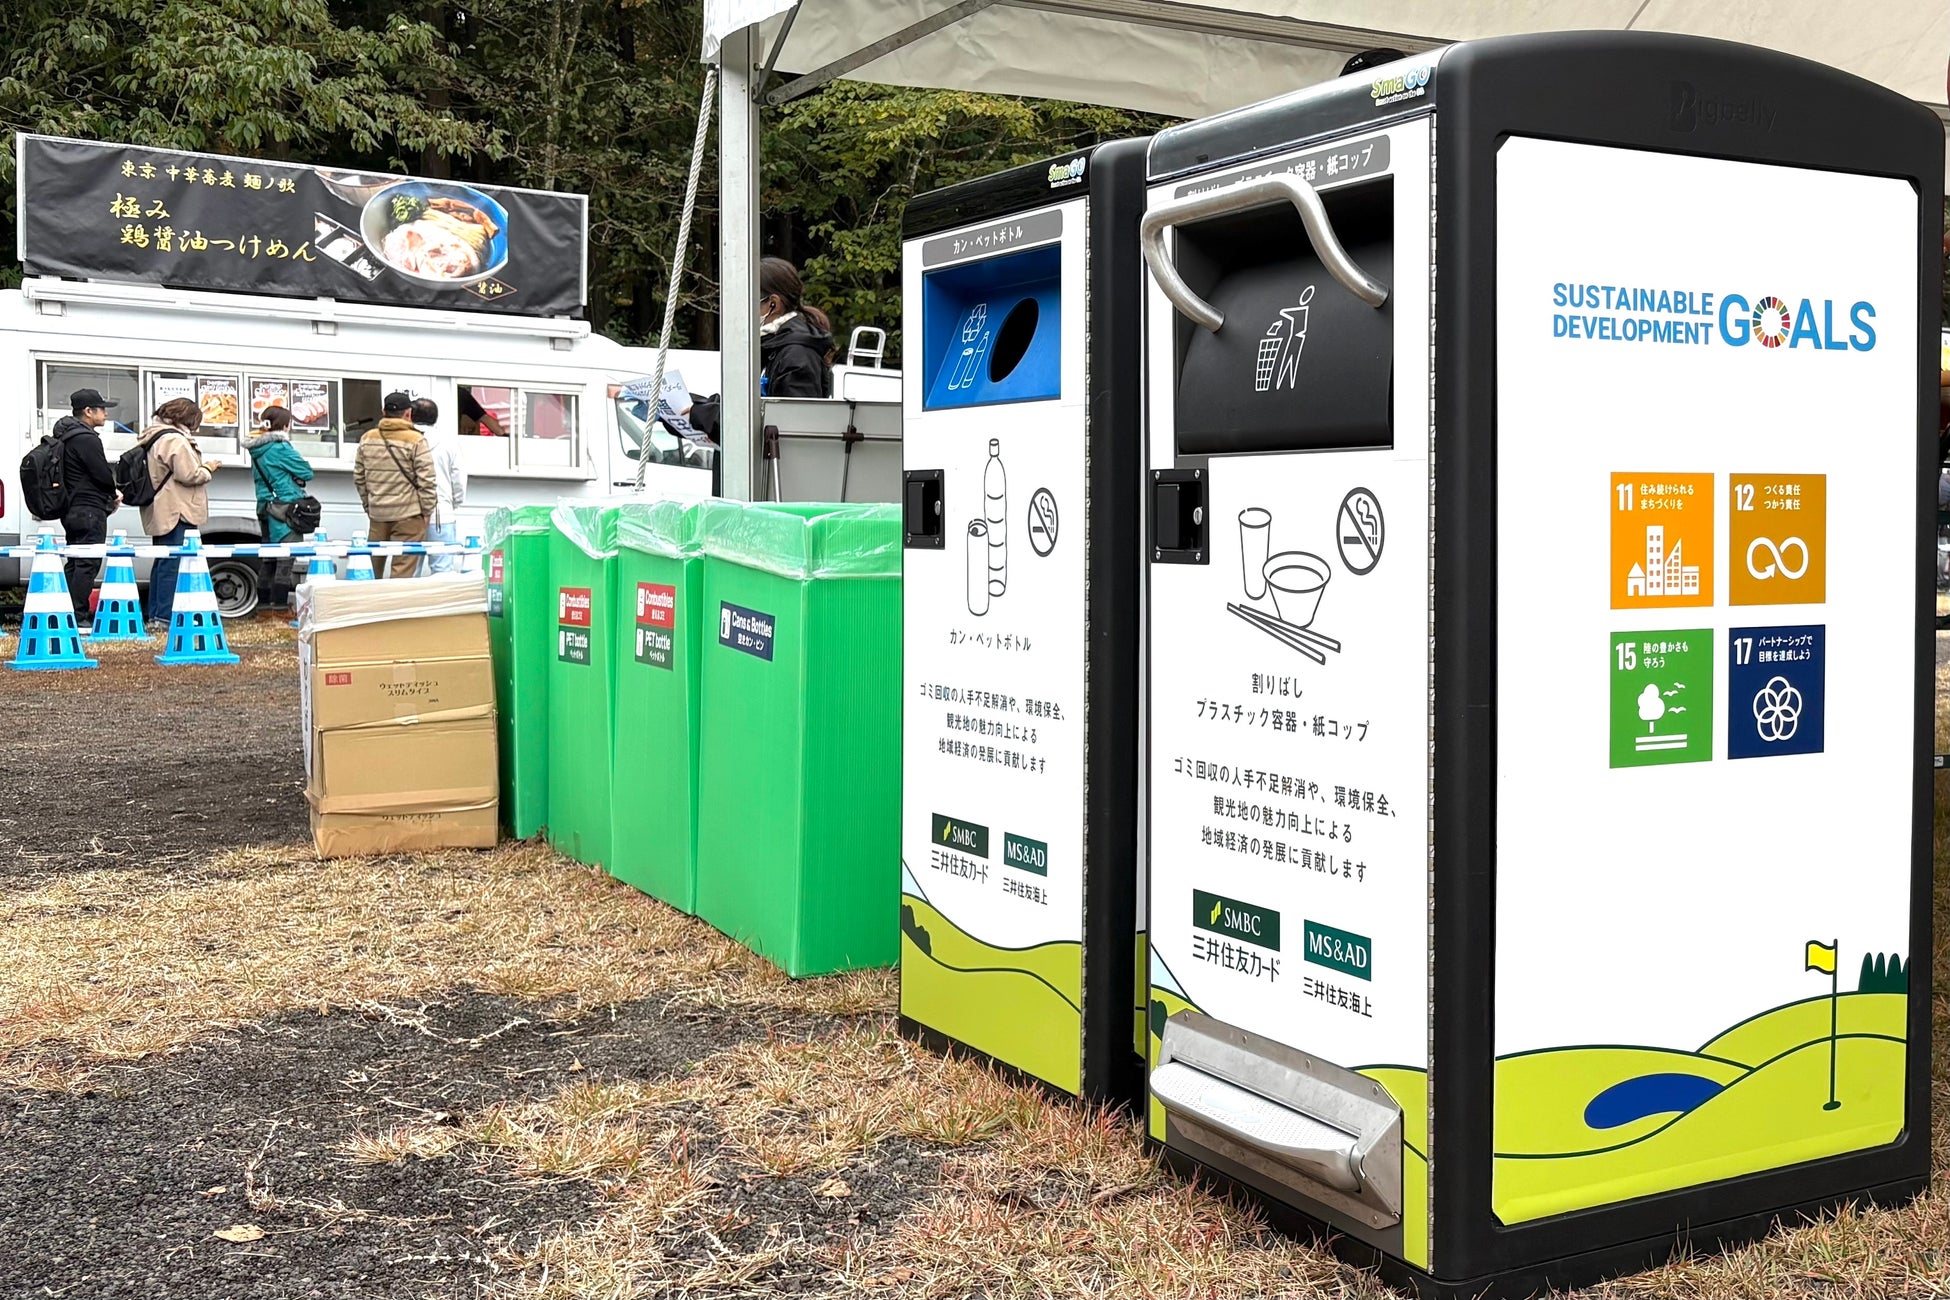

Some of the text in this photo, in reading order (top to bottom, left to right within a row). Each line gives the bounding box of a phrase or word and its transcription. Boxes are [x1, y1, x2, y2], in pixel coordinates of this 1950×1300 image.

[1370, 65, 1431, 98] SmaGO
[121, 160, 157, 180] 東京
[165, 165, 235, 189] 中華蕎麦
[109, 192, 170, 220] 極み
[120, 223, 317, 262] 鶏醤油つけめん
[953, 225, 1023, 255] カン・ペットボトル
[1553, 282, 1714, 316] SUSTAINABLE
[1553, 314, 1714, 345] DEVELOPMENT
[1719, 293, 1876, 352] GOALS
[1616, 483, 1633, 511] 11
[1640, 483, 1694, 495] 住み続けられる
[1734, 484, 1754, 511] 12
[1764, 484, 1801, 495] つくる責任
[1640, 498, 1683, 510] まちづくりを
[1764, 499, 1801, 510] つかう責任
[732, 611, 747, 630] Cans
[751, 616, 772, 639] Bottles
[950, 628, 1031, 652] カン・ペットボトル
[1643, 641, 1689, 654] 陸の豊かさも
[1734, 638, 1752, 665] 17
[1759, 635, 1813, 647] パートナーシップで
[1615, 642, 1637, 670] 15
[1643, 657, 1666, 669] 守ろう
[1759, 649, 1811, 663] 目標を達成しよう
[1252, 673, 1303, 698] 割りばし
[920, 682, 1065, 721] ゴミ回収の人手不足解消や、環境保全、
[947, 712, 1037, 744] 観光地の魅力向上による
[1196, 698, 1370, 742] プラスチック容器・紙コップ
[938, 737, 1046, 774] 地域経済の発展に貢献します
[1174, 757, 1397, 818] ゴミ回収の人手不足解消や、環境保全、
[1213, 795, 1352, 843] 観光地の魅力向上による
[952, 825, 977, 848] SMBC
[931, 850, 989, 884] 三井住友カード
[1007, 840, 1045, 868] MS&AD
[1201, 825, 1367, 882] 地域経済の発展に貢献します
[1003, 877, 1048, 906] 三井住友海上
[1224, 907, 1261, 937] SMBC
[1193, 935, 1280, 983] 三井住友カード
[1309, 931, 1367, 969] MS&AD
[1303, 976, 1373, 1018] 三井住友海上
